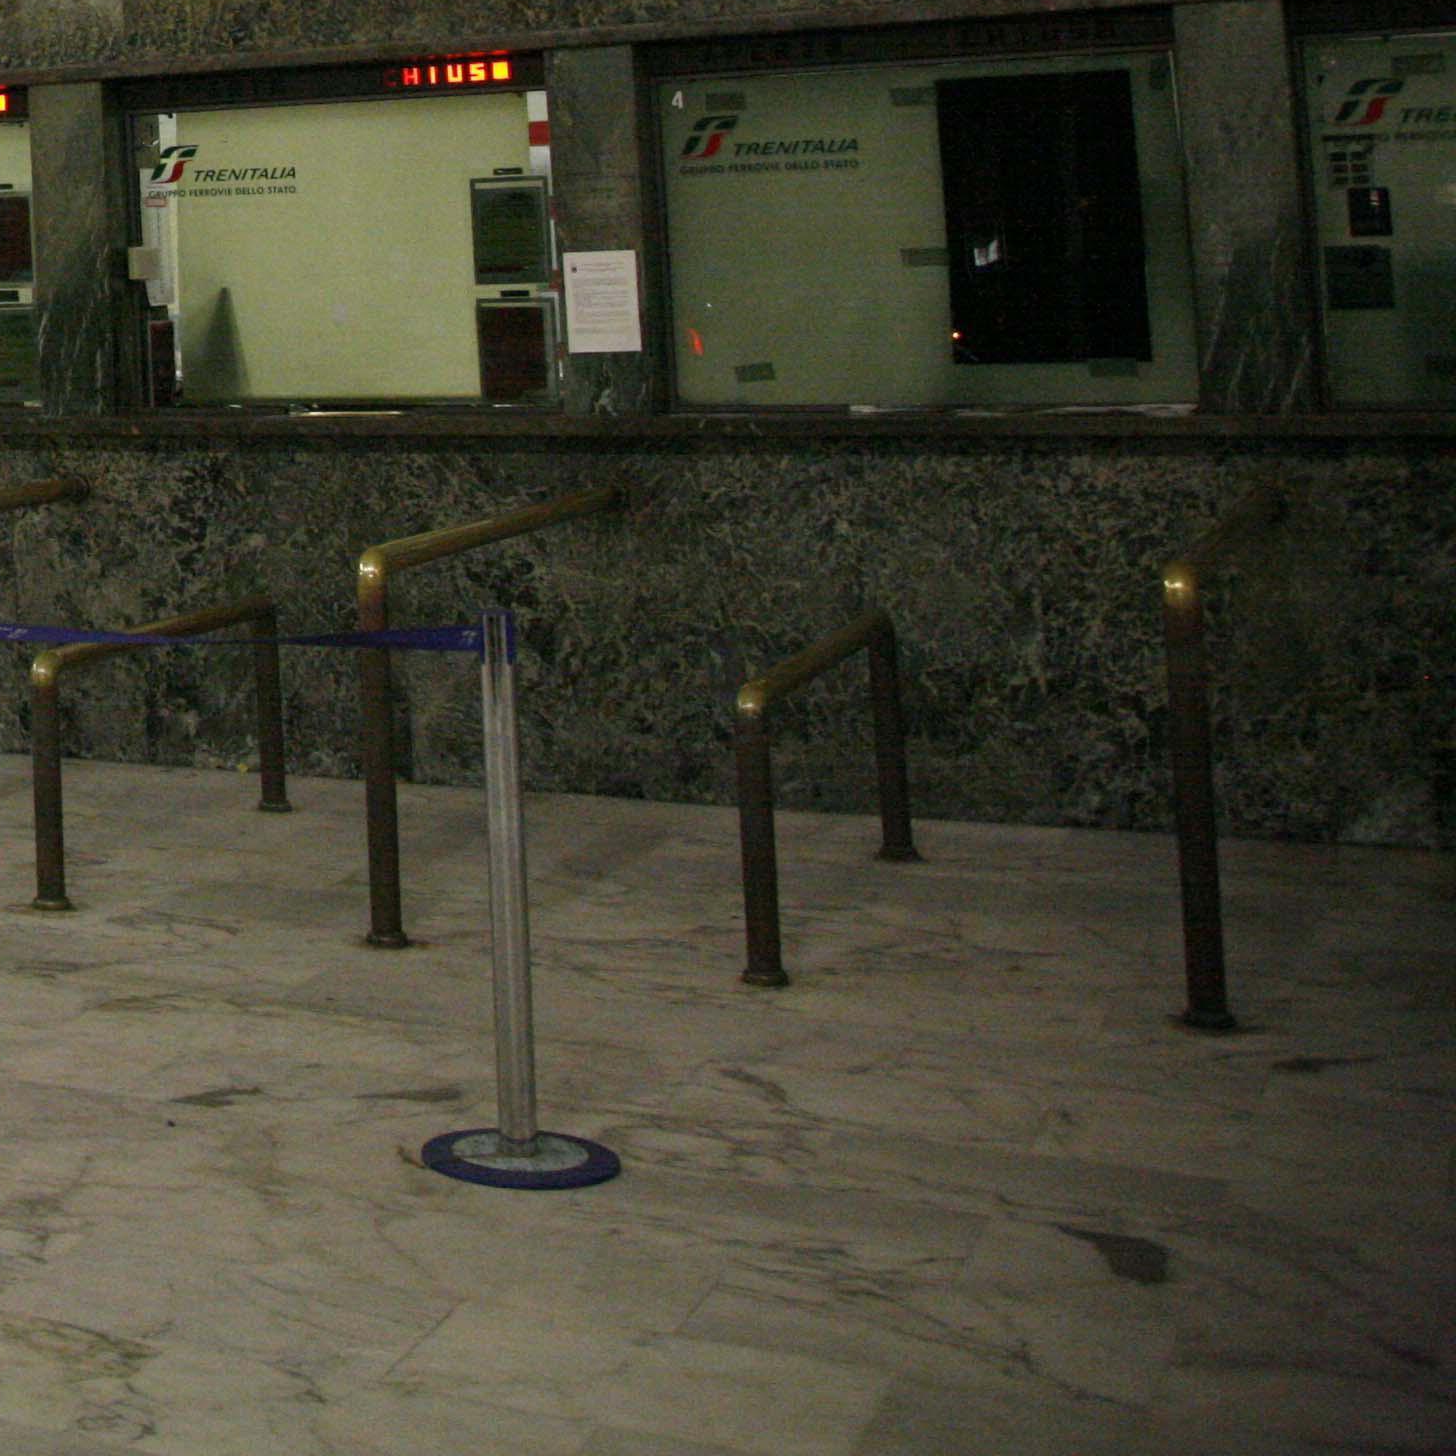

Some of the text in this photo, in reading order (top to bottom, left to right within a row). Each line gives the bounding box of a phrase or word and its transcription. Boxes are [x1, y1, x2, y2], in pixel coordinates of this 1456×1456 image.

[734, 138, 859, 157] TRENITALIA
[785, 160, 820, 171] DELLO
[823, 159, 859, 169] STATO
[193, 166, 296, 182] TRENITALIA
[148, 185, 296, 199] GRUPPO FERROVIE DELLO STATO
